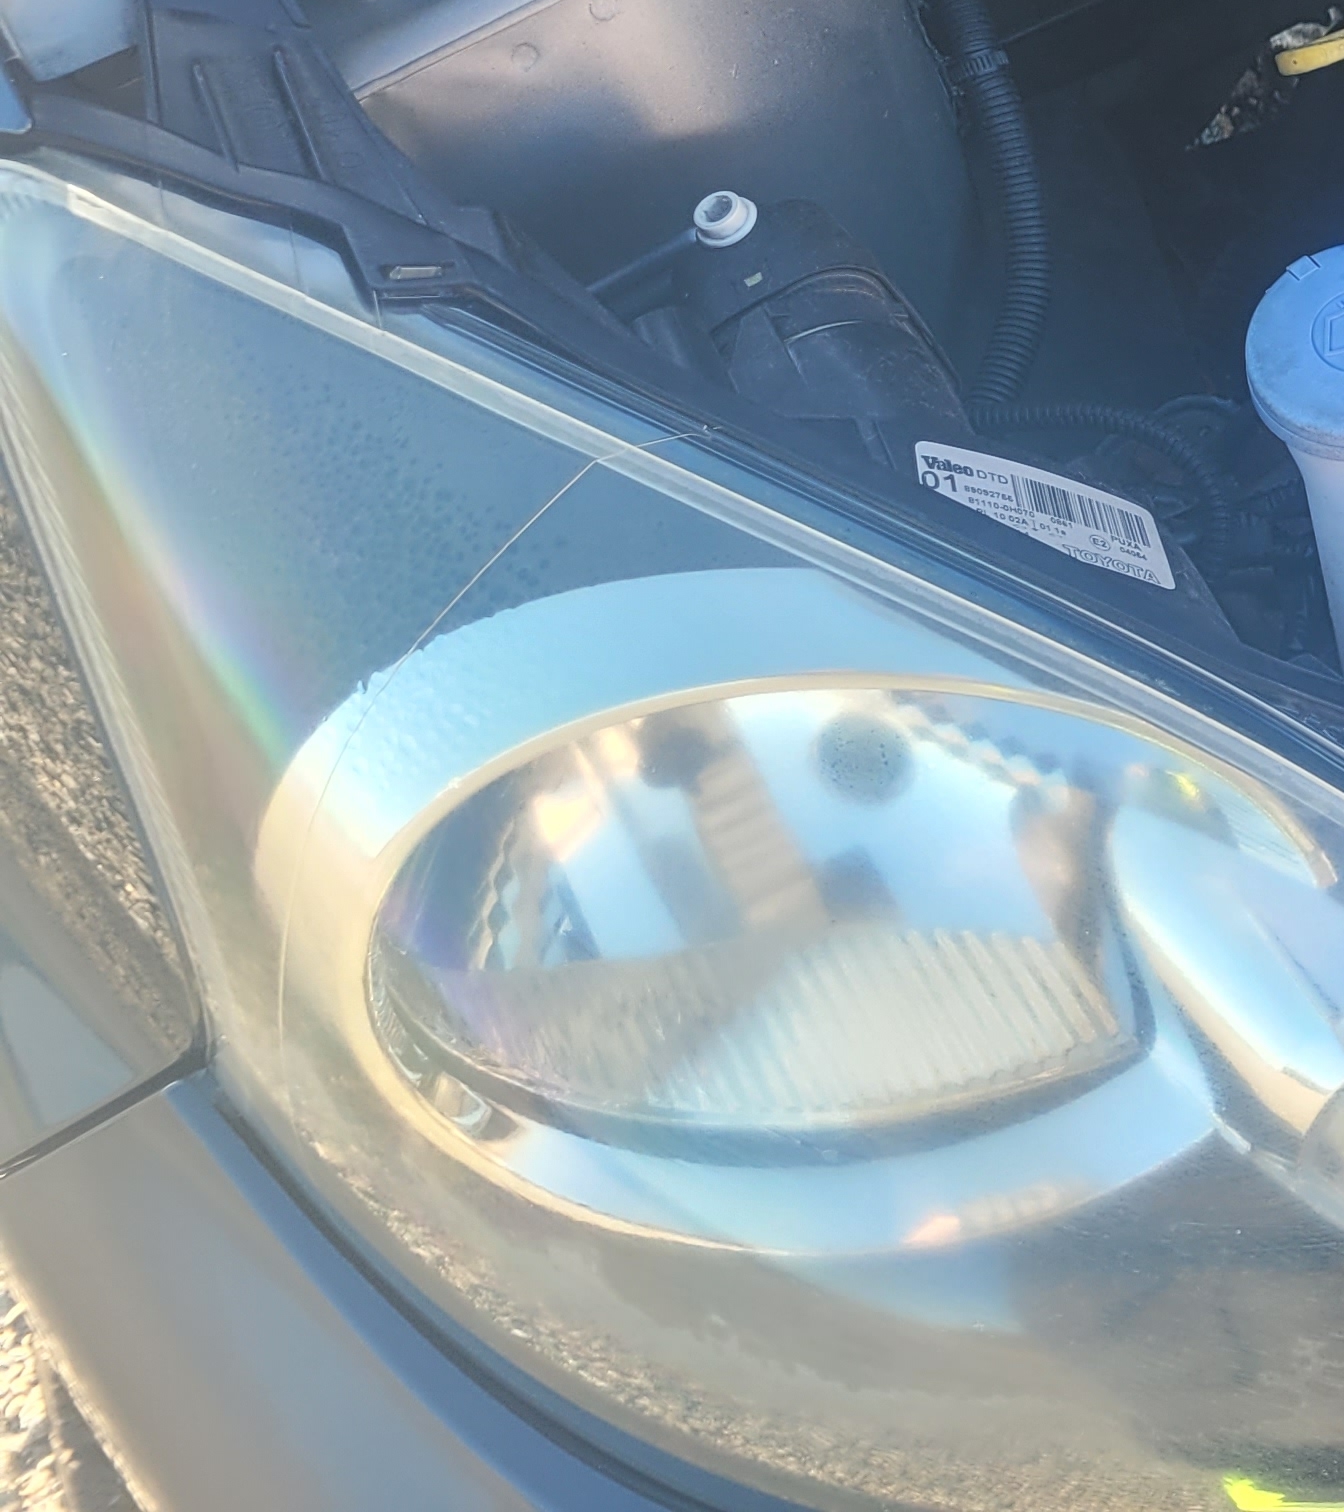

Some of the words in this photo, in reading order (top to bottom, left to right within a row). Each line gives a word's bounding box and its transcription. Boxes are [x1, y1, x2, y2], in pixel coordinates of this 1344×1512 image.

[921, 455, 974, 477] Valeo
[976, 469, 1008, 485] DTD
[921, 470, 957, 492] 01
[1111, 534, 1143, 552] PUXA
[1062, 543, 1161, 585] TOYOTA
